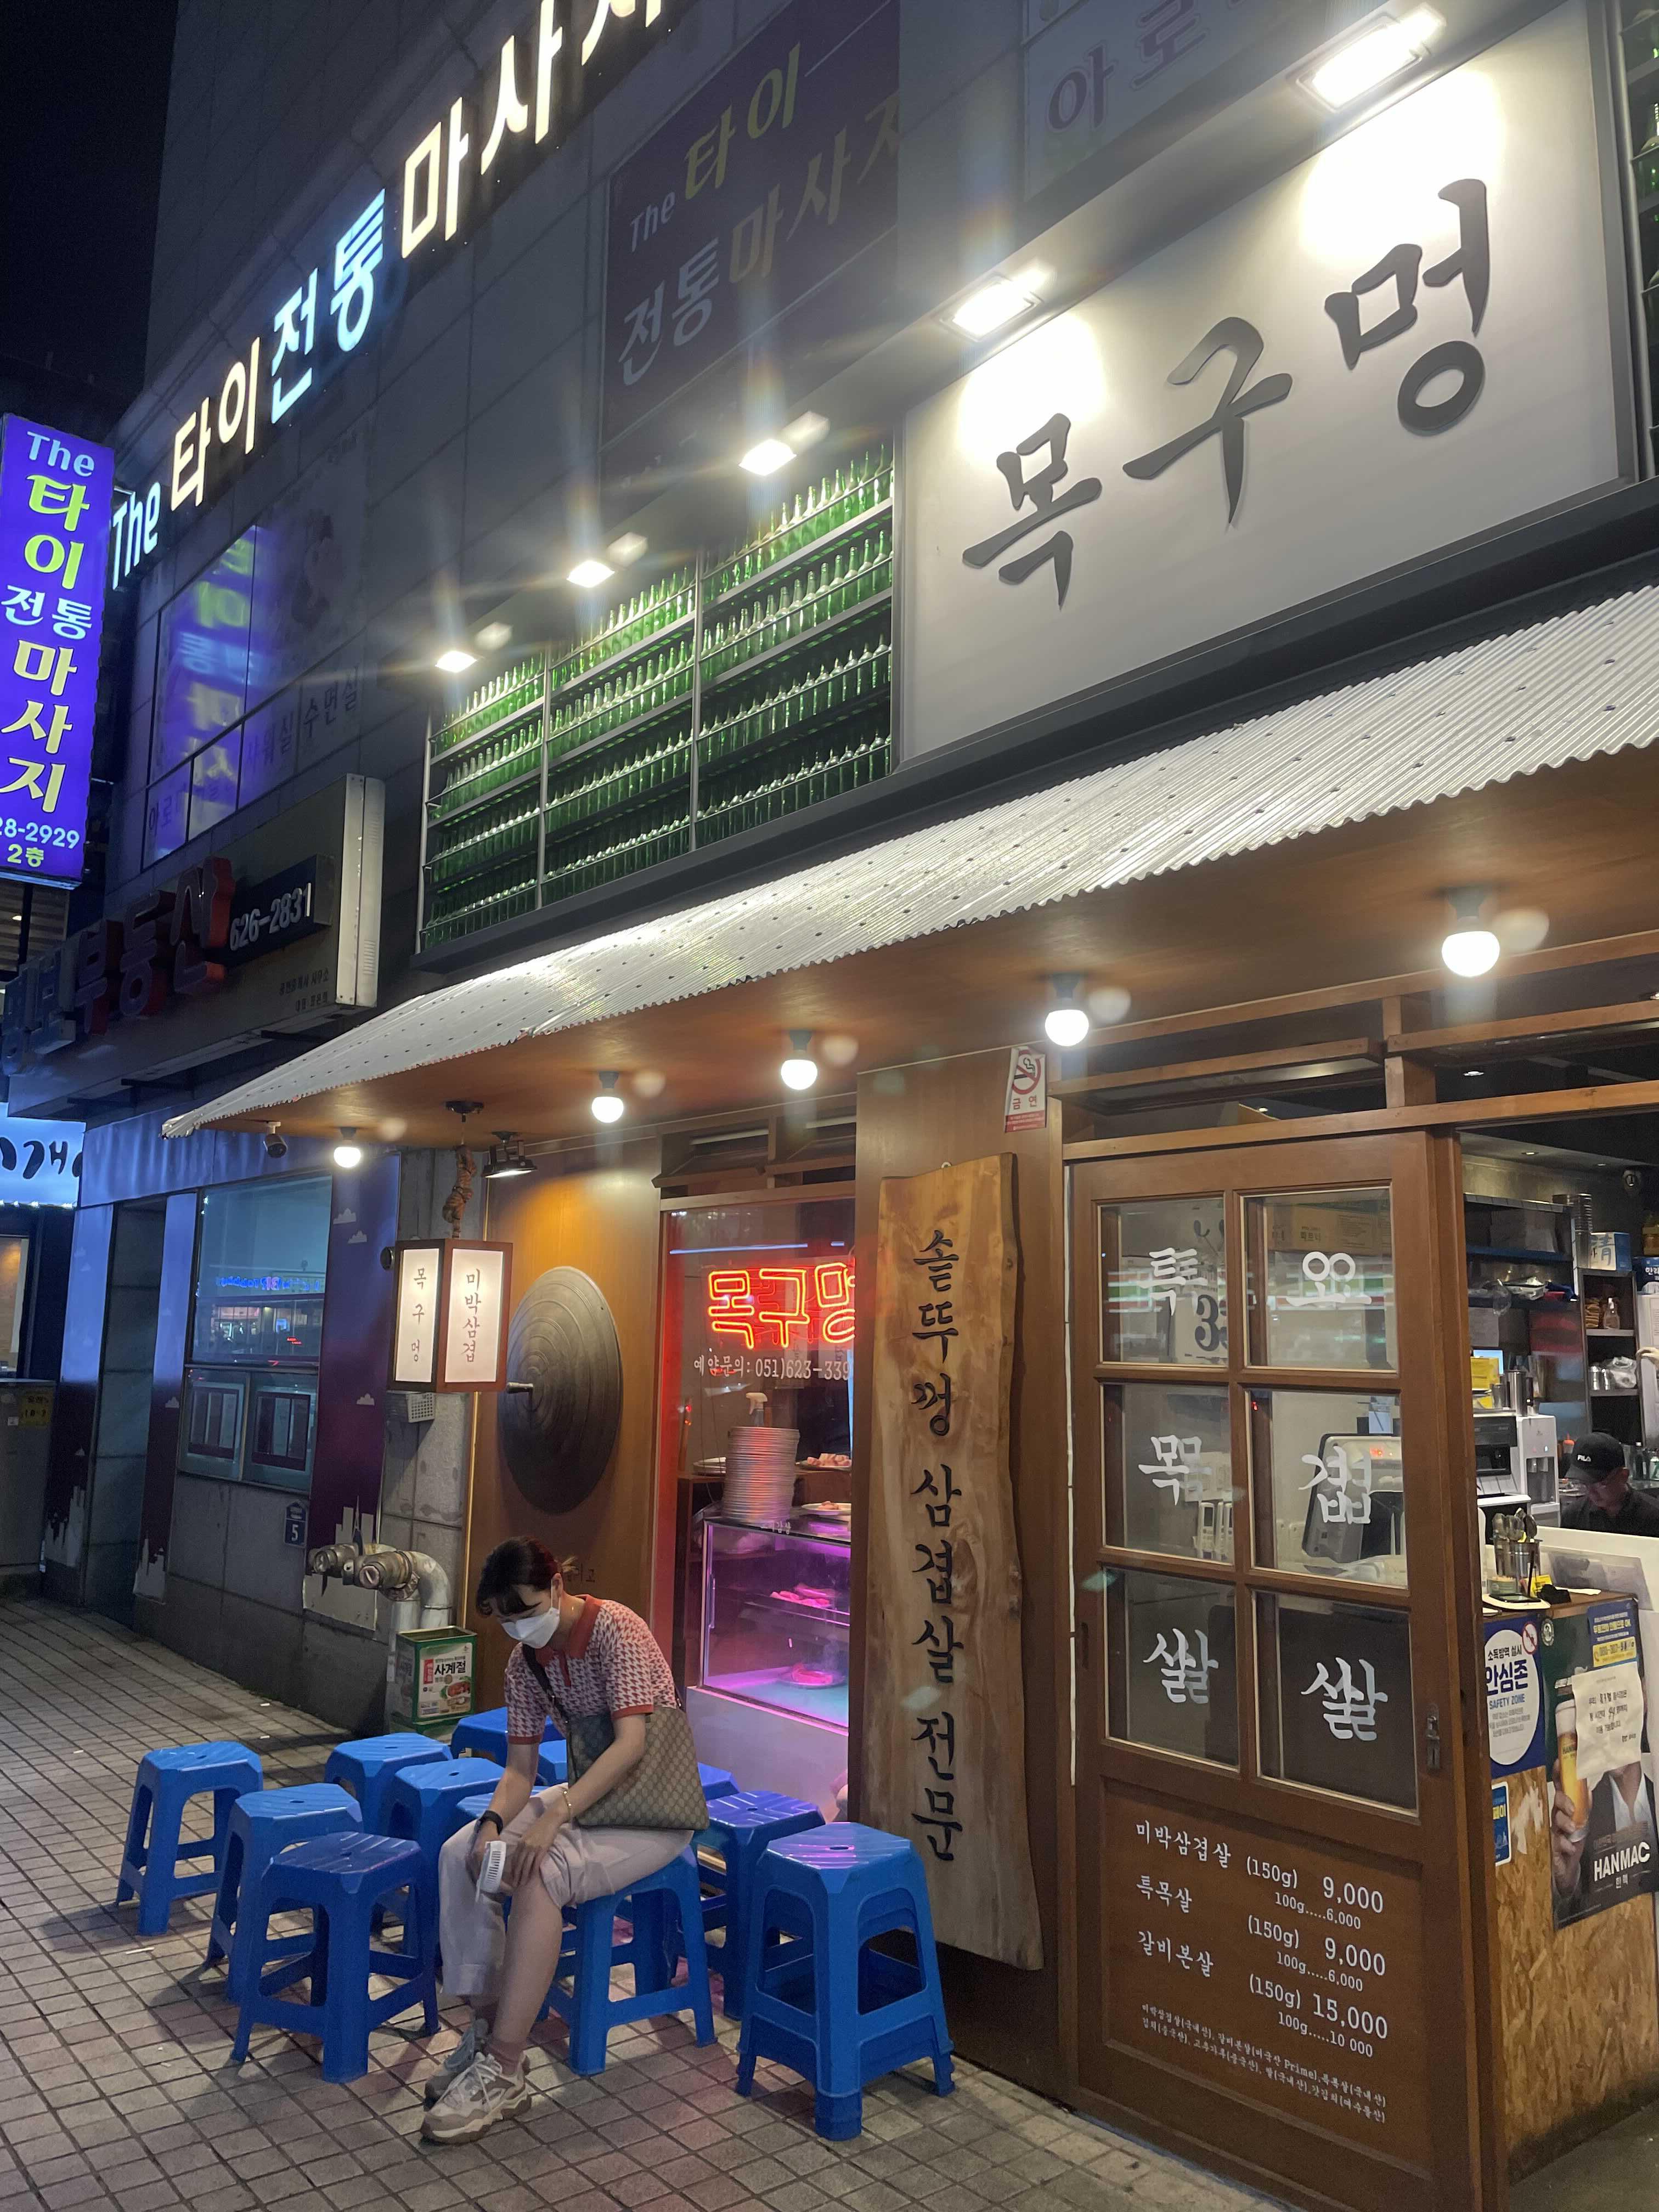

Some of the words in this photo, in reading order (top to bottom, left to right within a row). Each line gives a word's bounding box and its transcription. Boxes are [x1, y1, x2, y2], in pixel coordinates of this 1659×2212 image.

[629, 191, 676, 255] The
[684, 41, 802, 205] 타이
[111, 481, 161, 591] The
[171, 336, 261, 512] 타이
[271, 188, 385, 425] 전통
[962, 178, 1491, 609] 목구멍
[26, 431, 96, 478] The
[24, 474, 90, 590] 타이
[1, 583, 93, 641] 전통
[1, 639, 77, 814] 마사지
[0, 816, 80, 849] 8-2929
[7, 844, 44, 868] 2층
[229, 882, 313, 953] 626-2831
[1012, 1095, 1037, 1110] 금연
[411, 1268, 427, 1362] 목구멍
[461, 1268, 482, 1363] 미박삼겹
[693, 1355, 750, 1378] 예약문의:
[291, 1523, 299, 1542] 5
[911, 1464, 964, 1684] 삼겹살
[434, 1660, 466, 1675] 사계절
[1486, 1658, 1528, 1695] 안심존
[1489, 1696, 1509, 1710] SAFETY
[1511, 1694, 1526, 1705] ZONE
[911, 1711, 963, 1862] 전문
[1136, 1819, 1232, 1869] 미박삼겹살
[1246, 1856, 1298, 1889] (150g)
[1323, 1876, 1384, 1914] 9,000
[1594, 1841, 1651, 1882] HANMAC
[1136, 1875, 1193, 1914] 특목살
[1248, 1915, 1300, 1949] (150g)
[1324, 1937, 1386, 1976] 9,000
[1137, 1931, 1214, 1977] 갈비본살
[1249, 1973, 1301, 2010] (150g)
[1312, 1993, 1388, 2039] 15,000
